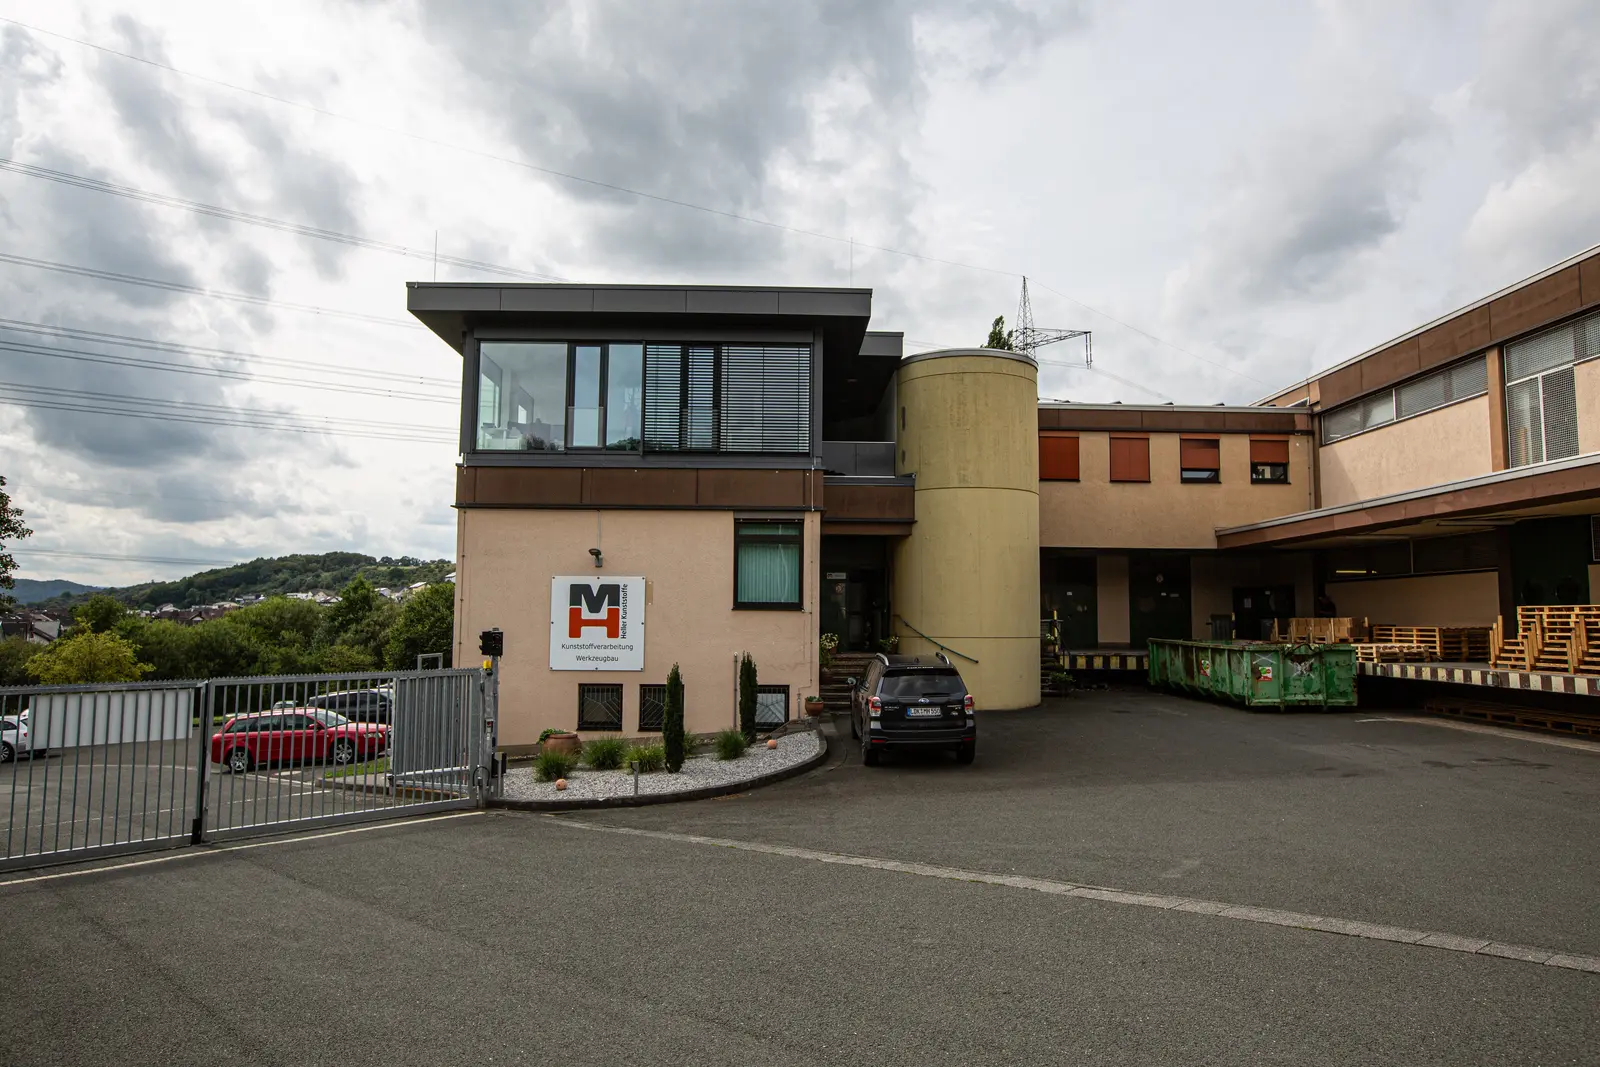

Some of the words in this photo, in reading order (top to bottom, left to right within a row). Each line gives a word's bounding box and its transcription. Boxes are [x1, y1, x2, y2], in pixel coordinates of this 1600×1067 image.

[620, 620, 628, 639] Heller
[561, 642, 634, 651] Kunststoffverarbeitung
[576, 655, 619, 663] Werkzeugbau
